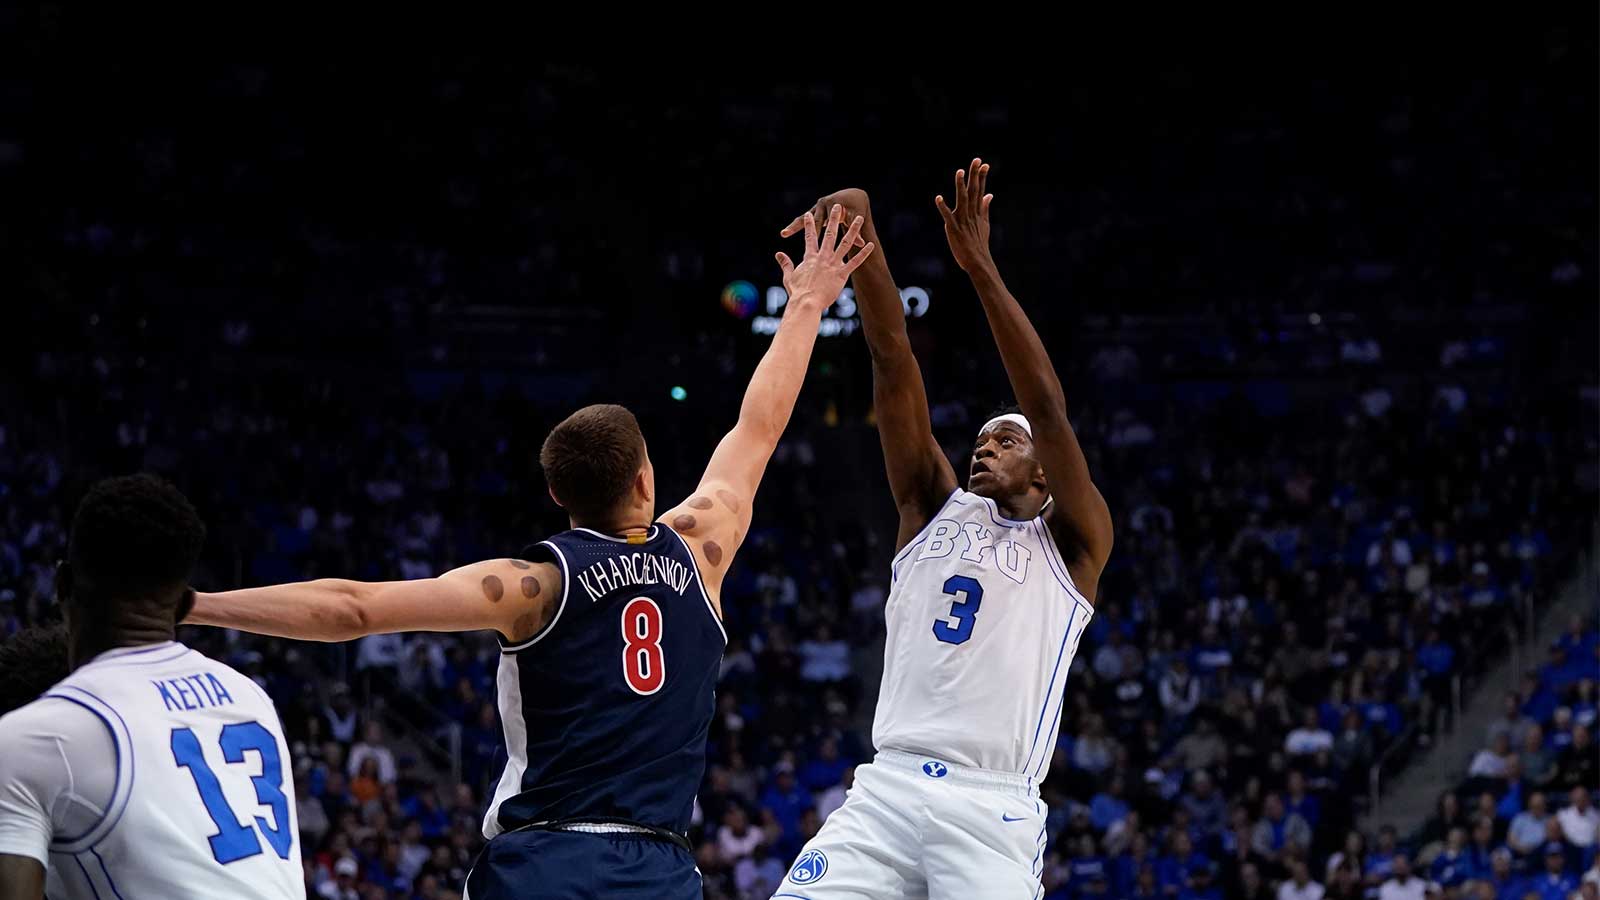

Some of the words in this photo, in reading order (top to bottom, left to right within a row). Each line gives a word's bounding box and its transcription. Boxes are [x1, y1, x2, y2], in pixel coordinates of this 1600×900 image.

[917, 518, 1032, 584] BYU
[932, 574, 984, 645] 3
[621, 596, 665, 696] 8
[150, 672, 235, 712] KEITA
[170, 721, 292, 865] 13
